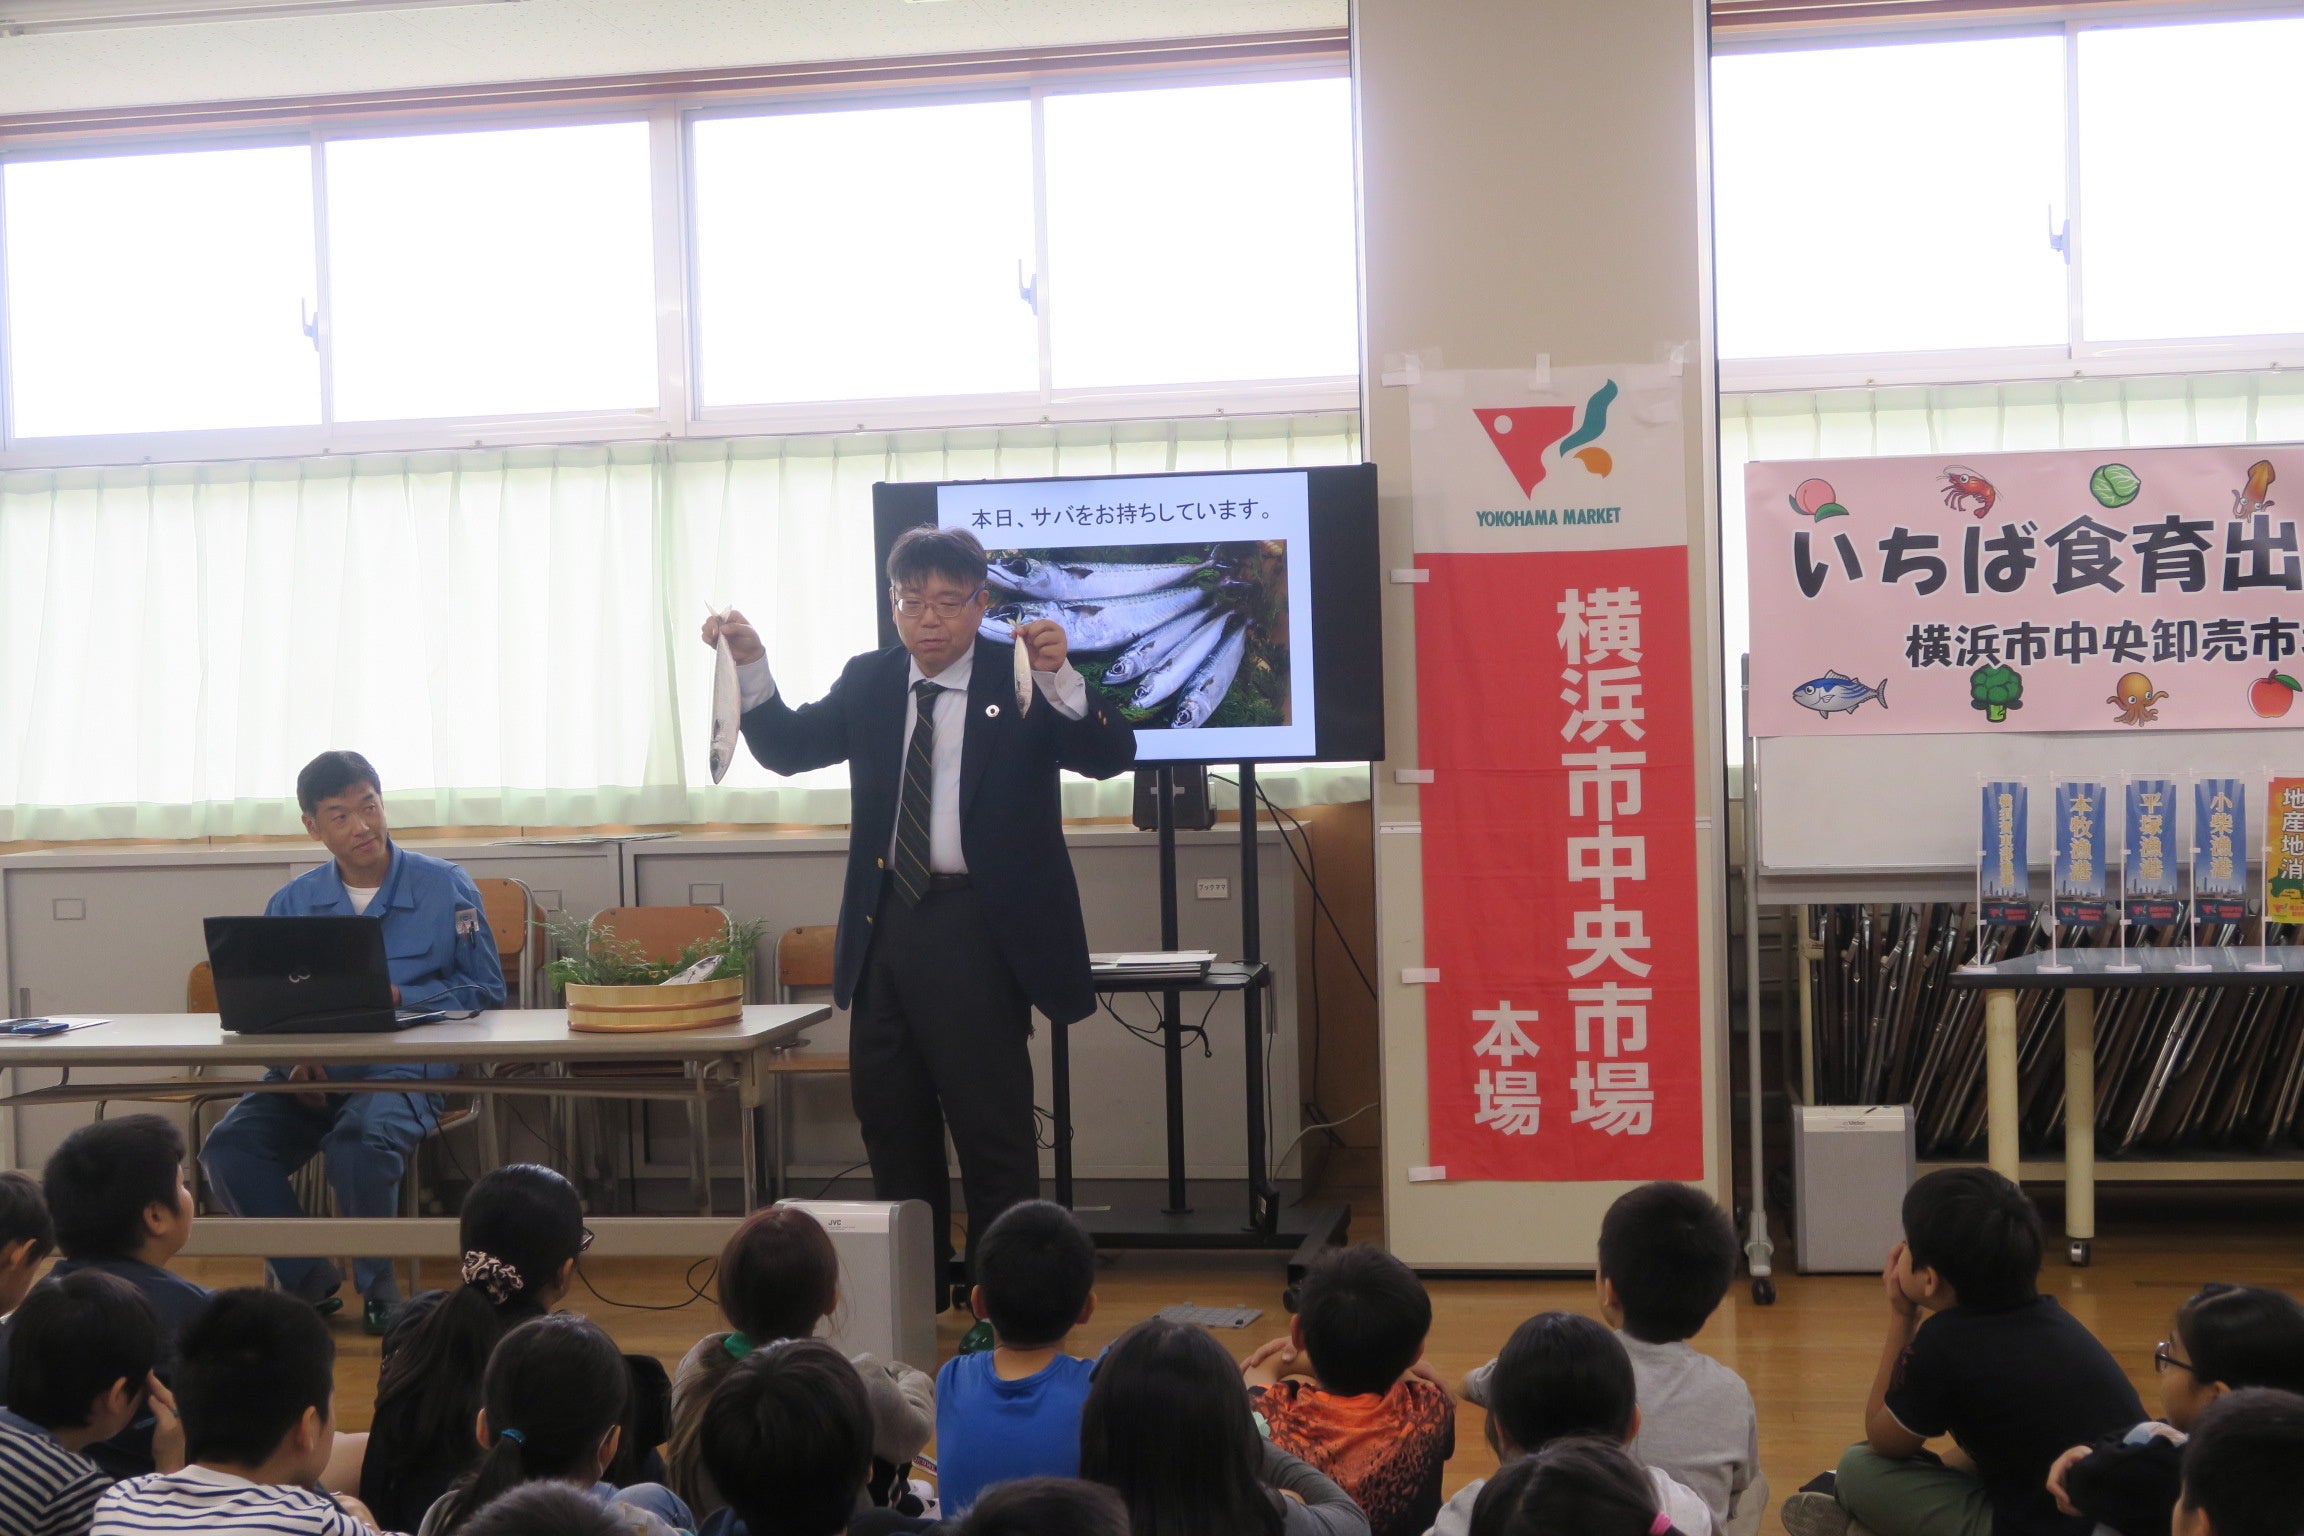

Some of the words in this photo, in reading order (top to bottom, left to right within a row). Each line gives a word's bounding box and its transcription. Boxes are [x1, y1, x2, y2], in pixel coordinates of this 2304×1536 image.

[971, 498, 1269, 530] 本日、サバをお持ちしています。
[1476, 508, 1558, 527] YOKOHAMA
[1563, 507, 1621, 525] MARKET
[1793, 514, 2303, 599] いちば食育出
[1905, 616, 2304, 669] 横浜市中央卸売市
[1557, 586, 1654, 1137] 横浜市中央市場
[2069, 793, 2094, 882] 本牧漁港
[2138, 792, 2163, 880] 平塚漁港
[2210, 792, 2233, 879] 小柴漁港
[2281, 787, 2304, 880] 地産地消
[1471, 1000, 1542, 1136] 本場
